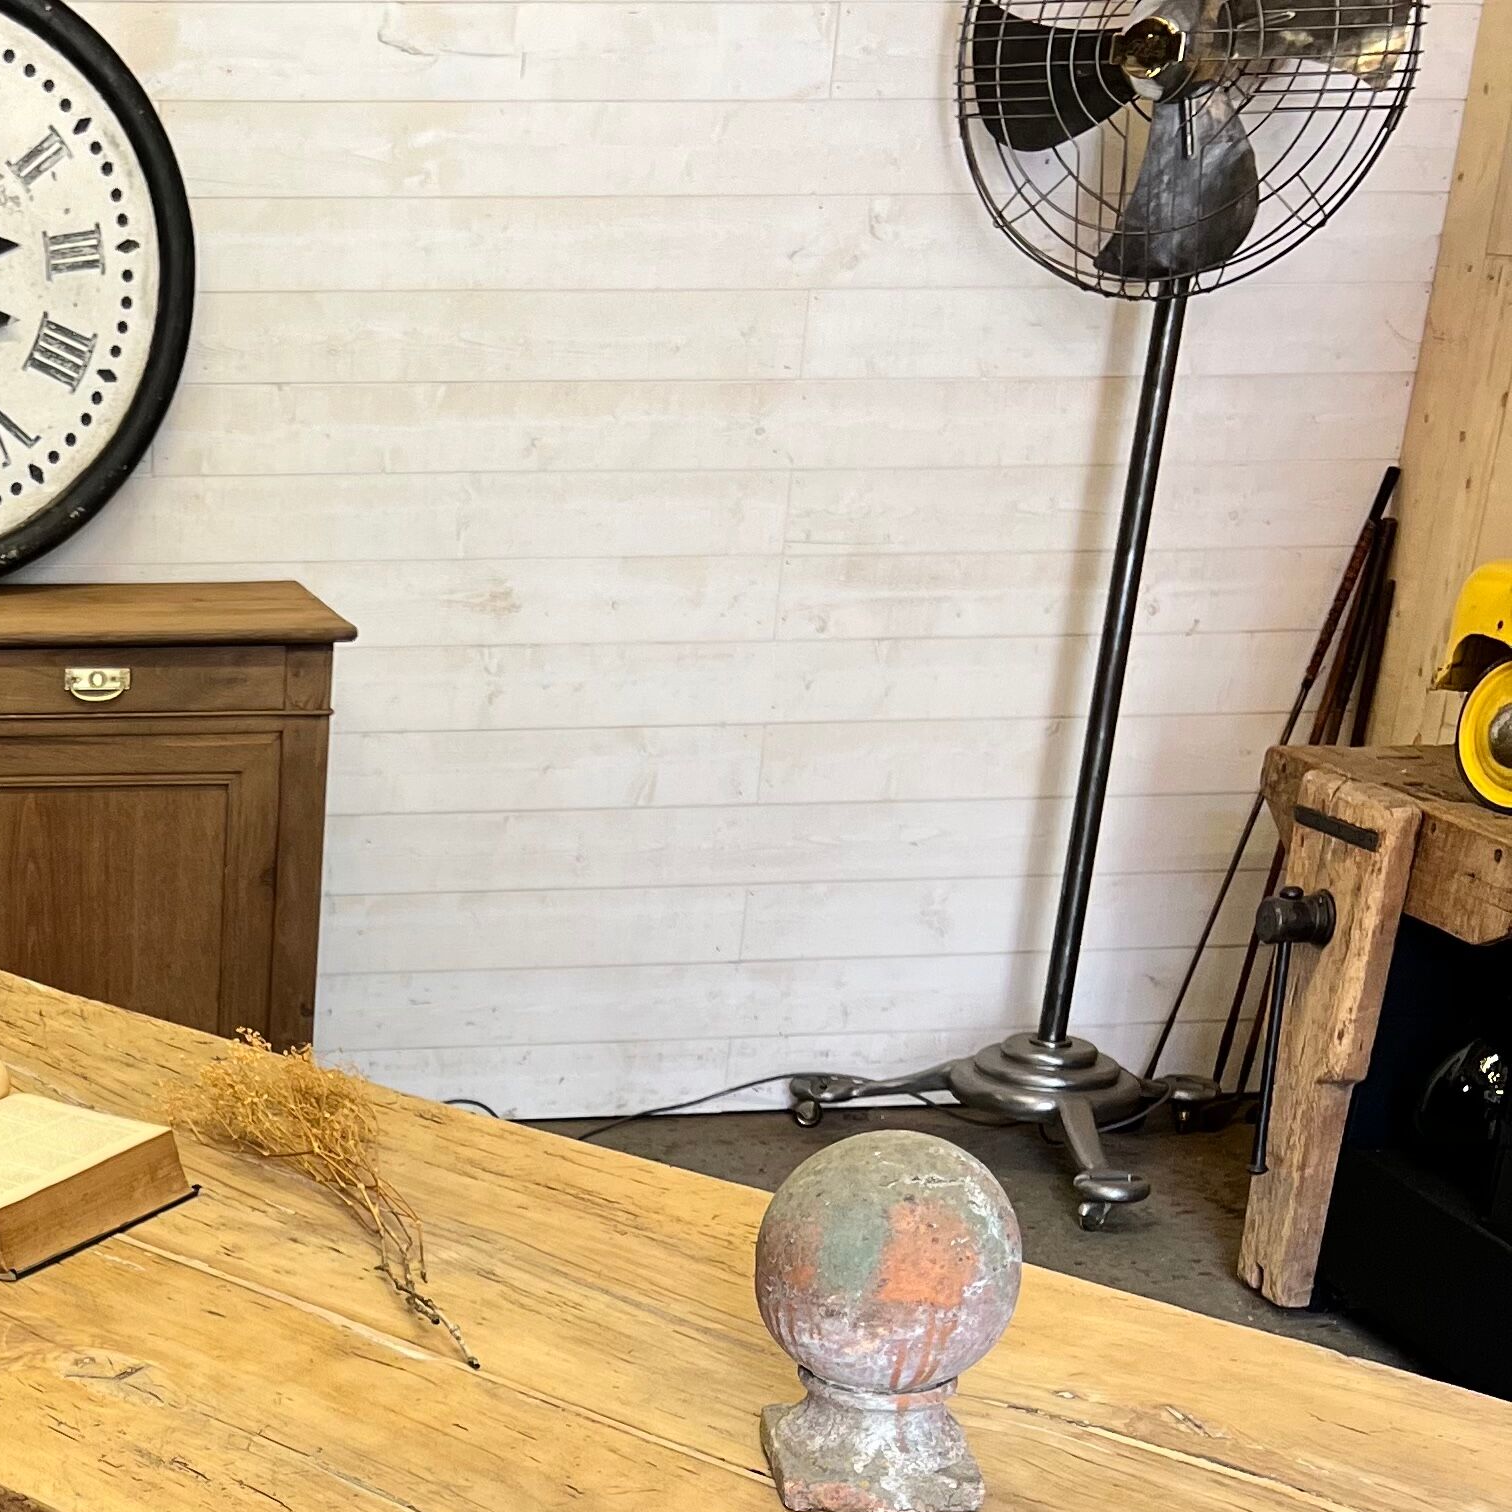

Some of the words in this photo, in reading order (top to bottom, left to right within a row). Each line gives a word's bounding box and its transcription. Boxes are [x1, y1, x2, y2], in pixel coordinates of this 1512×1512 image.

[5, 124, 73, 194] II
[43, 222, 106, 282] III
[22, 311, 98, 394] IIII
